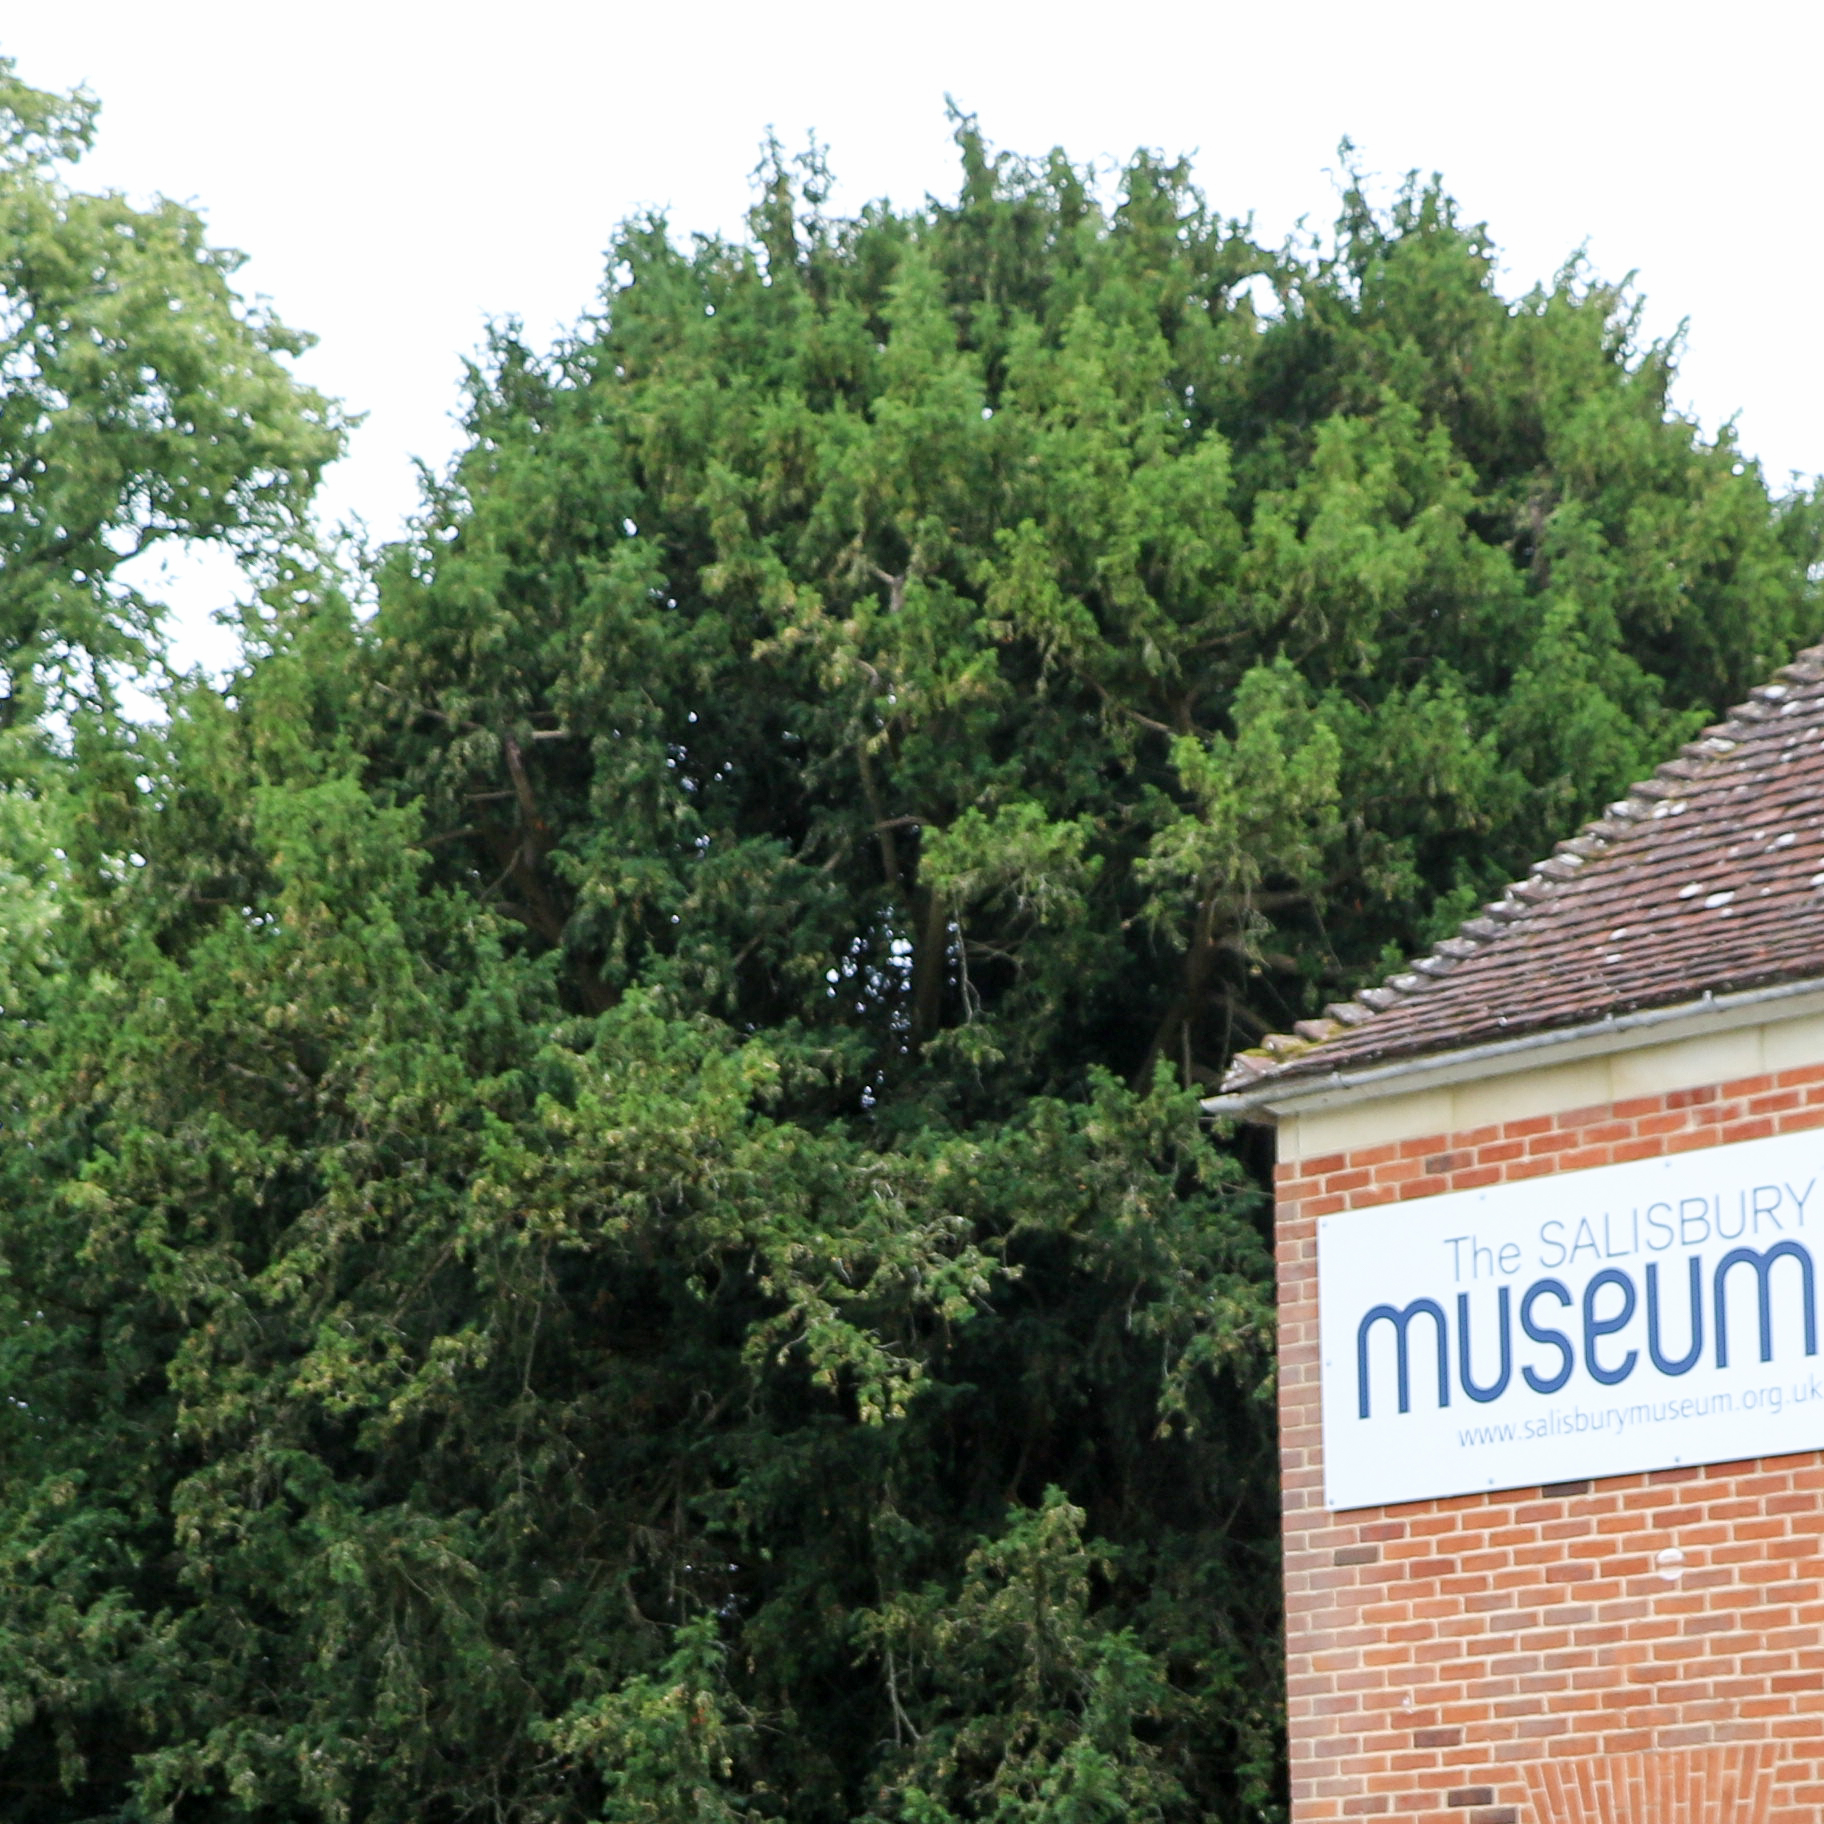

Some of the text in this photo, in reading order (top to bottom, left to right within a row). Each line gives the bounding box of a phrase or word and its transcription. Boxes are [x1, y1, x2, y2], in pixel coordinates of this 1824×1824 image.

[1443, 1177, 1817, 1282] The SALISBURY
[1356, 1240, 1818, 1420] museum
[1458, 1372, 1824, 1448] www.salisburymuseum.org.uk
